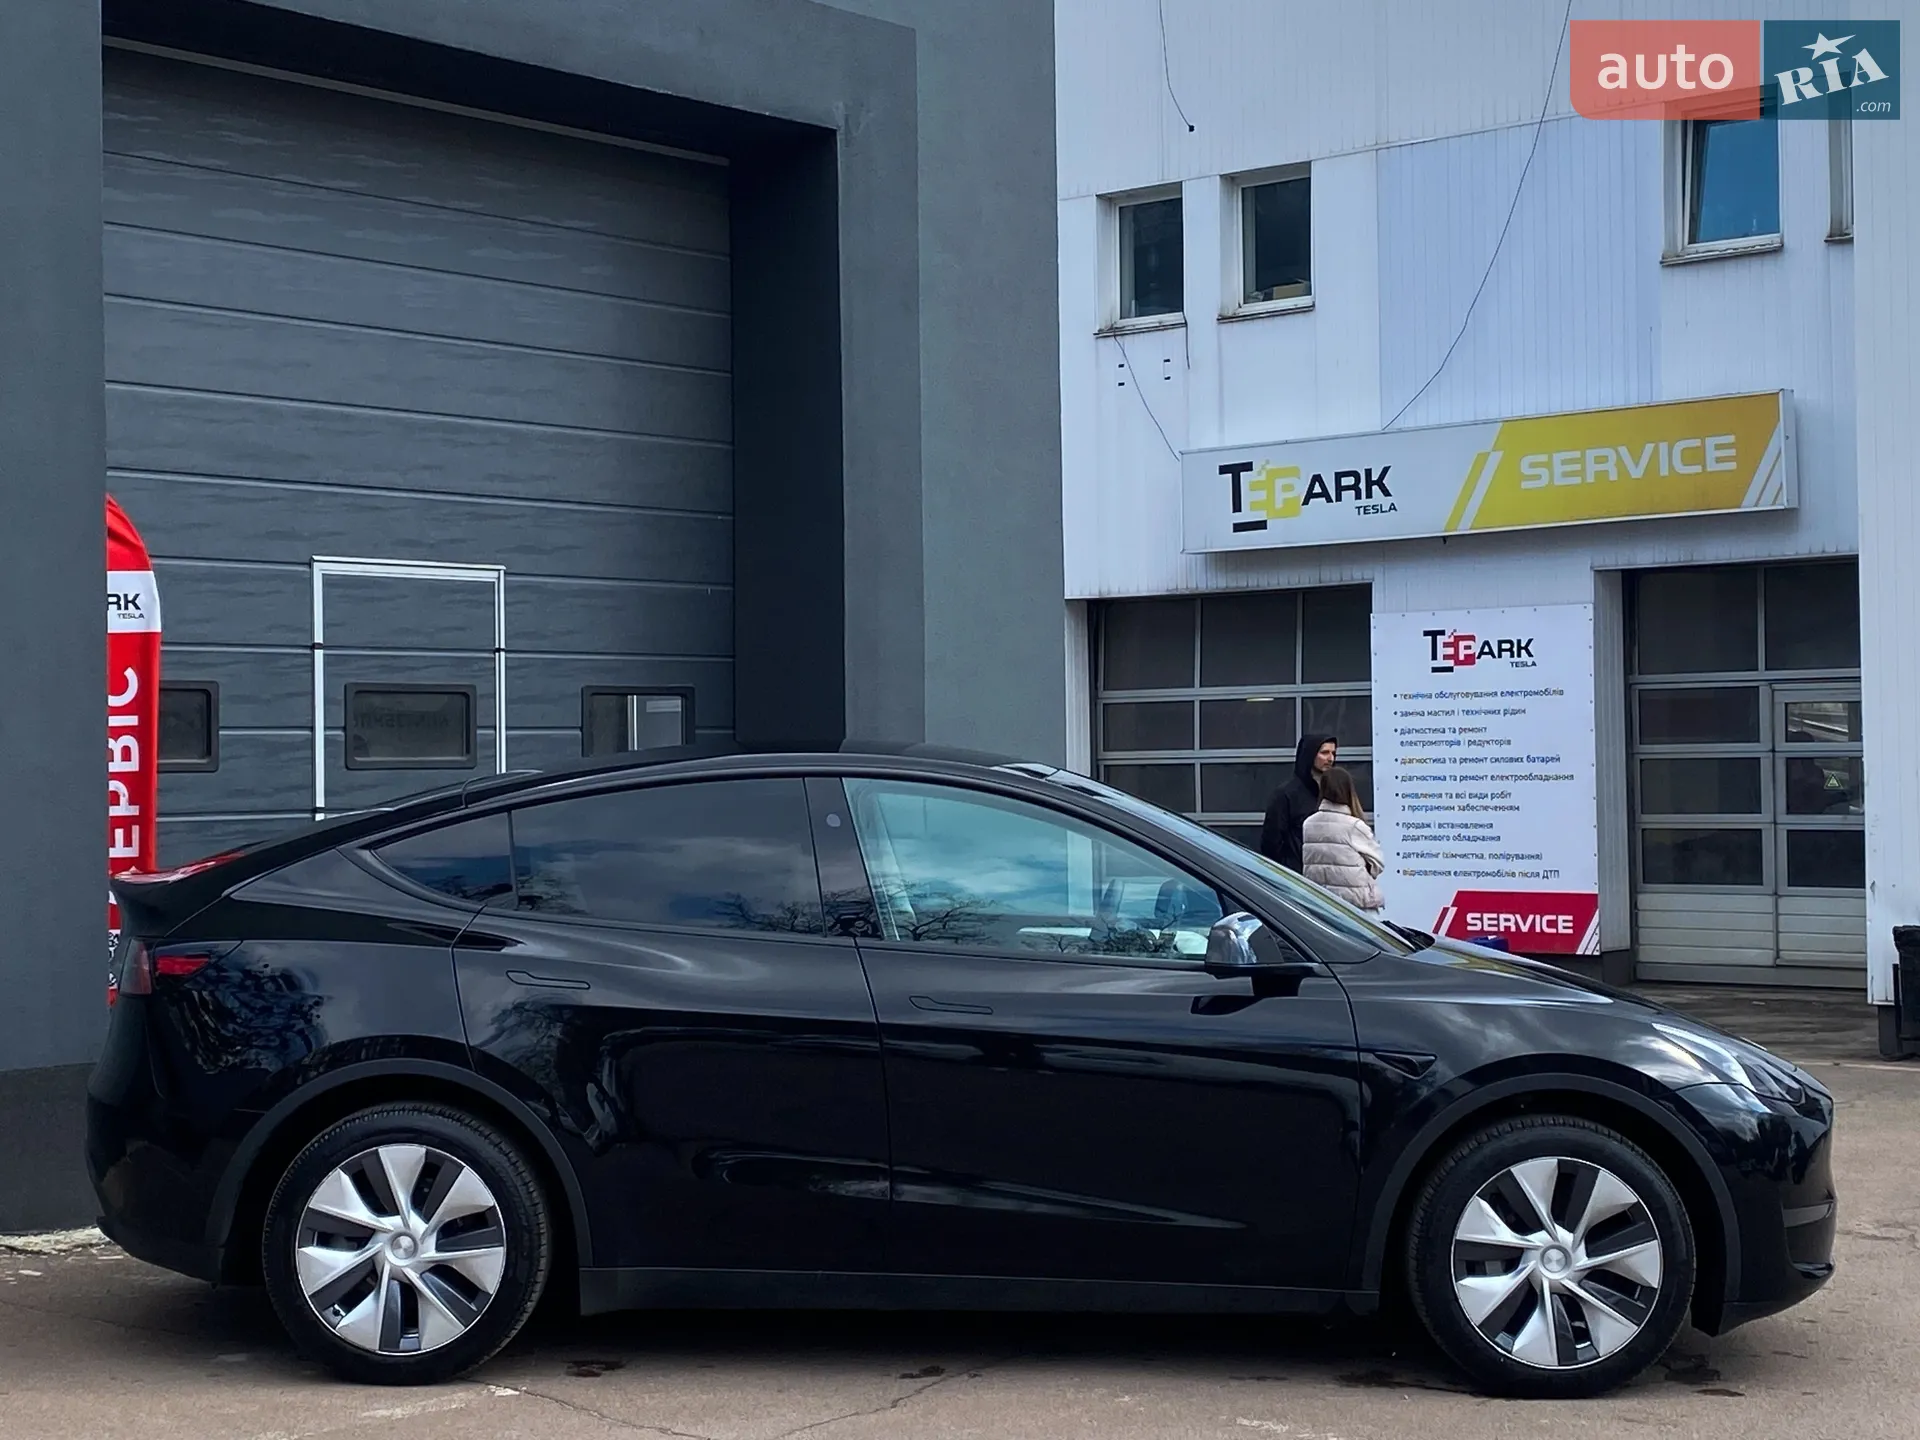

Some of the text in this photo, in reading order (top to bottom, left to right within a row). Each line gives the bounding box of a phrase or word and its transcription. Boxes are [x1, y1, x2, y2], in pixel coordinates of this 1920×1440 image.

[1519, 433, 1738, 489] SERVICE
[1355, 502, 1398, 516] TESLA
[1400, 692, 1433, 700] технічна
[1500, 687, 1564, 699] електромобілів
[1427, 709, 1455, 717] мастил
[1503, 707, 1526, 717] рідин
[1400, 726, 1446, 735] діагностика
[1458, 726, 1487, 736] ремонт
[1400, 756, 1446, 765] діагностика
[1459, 756, 1488, 766] ремонт
[1526, 754, 1561, 765] батарей
[1401, 773, 1447, 782] діагностика
[1459, 774, 1488, 783] ремонт
[1455, 790, 1466, 799] всі
[1468, 792, 1488, 800] види
[1490, 789, 1512, 801] робіт
[1402, 821, 1431, 830] продаж
[1518, 868, 1540, 878] після
[1542, 869, 1560, 880] ДТП
[1466, 912, 1574, 934] SERVICE
